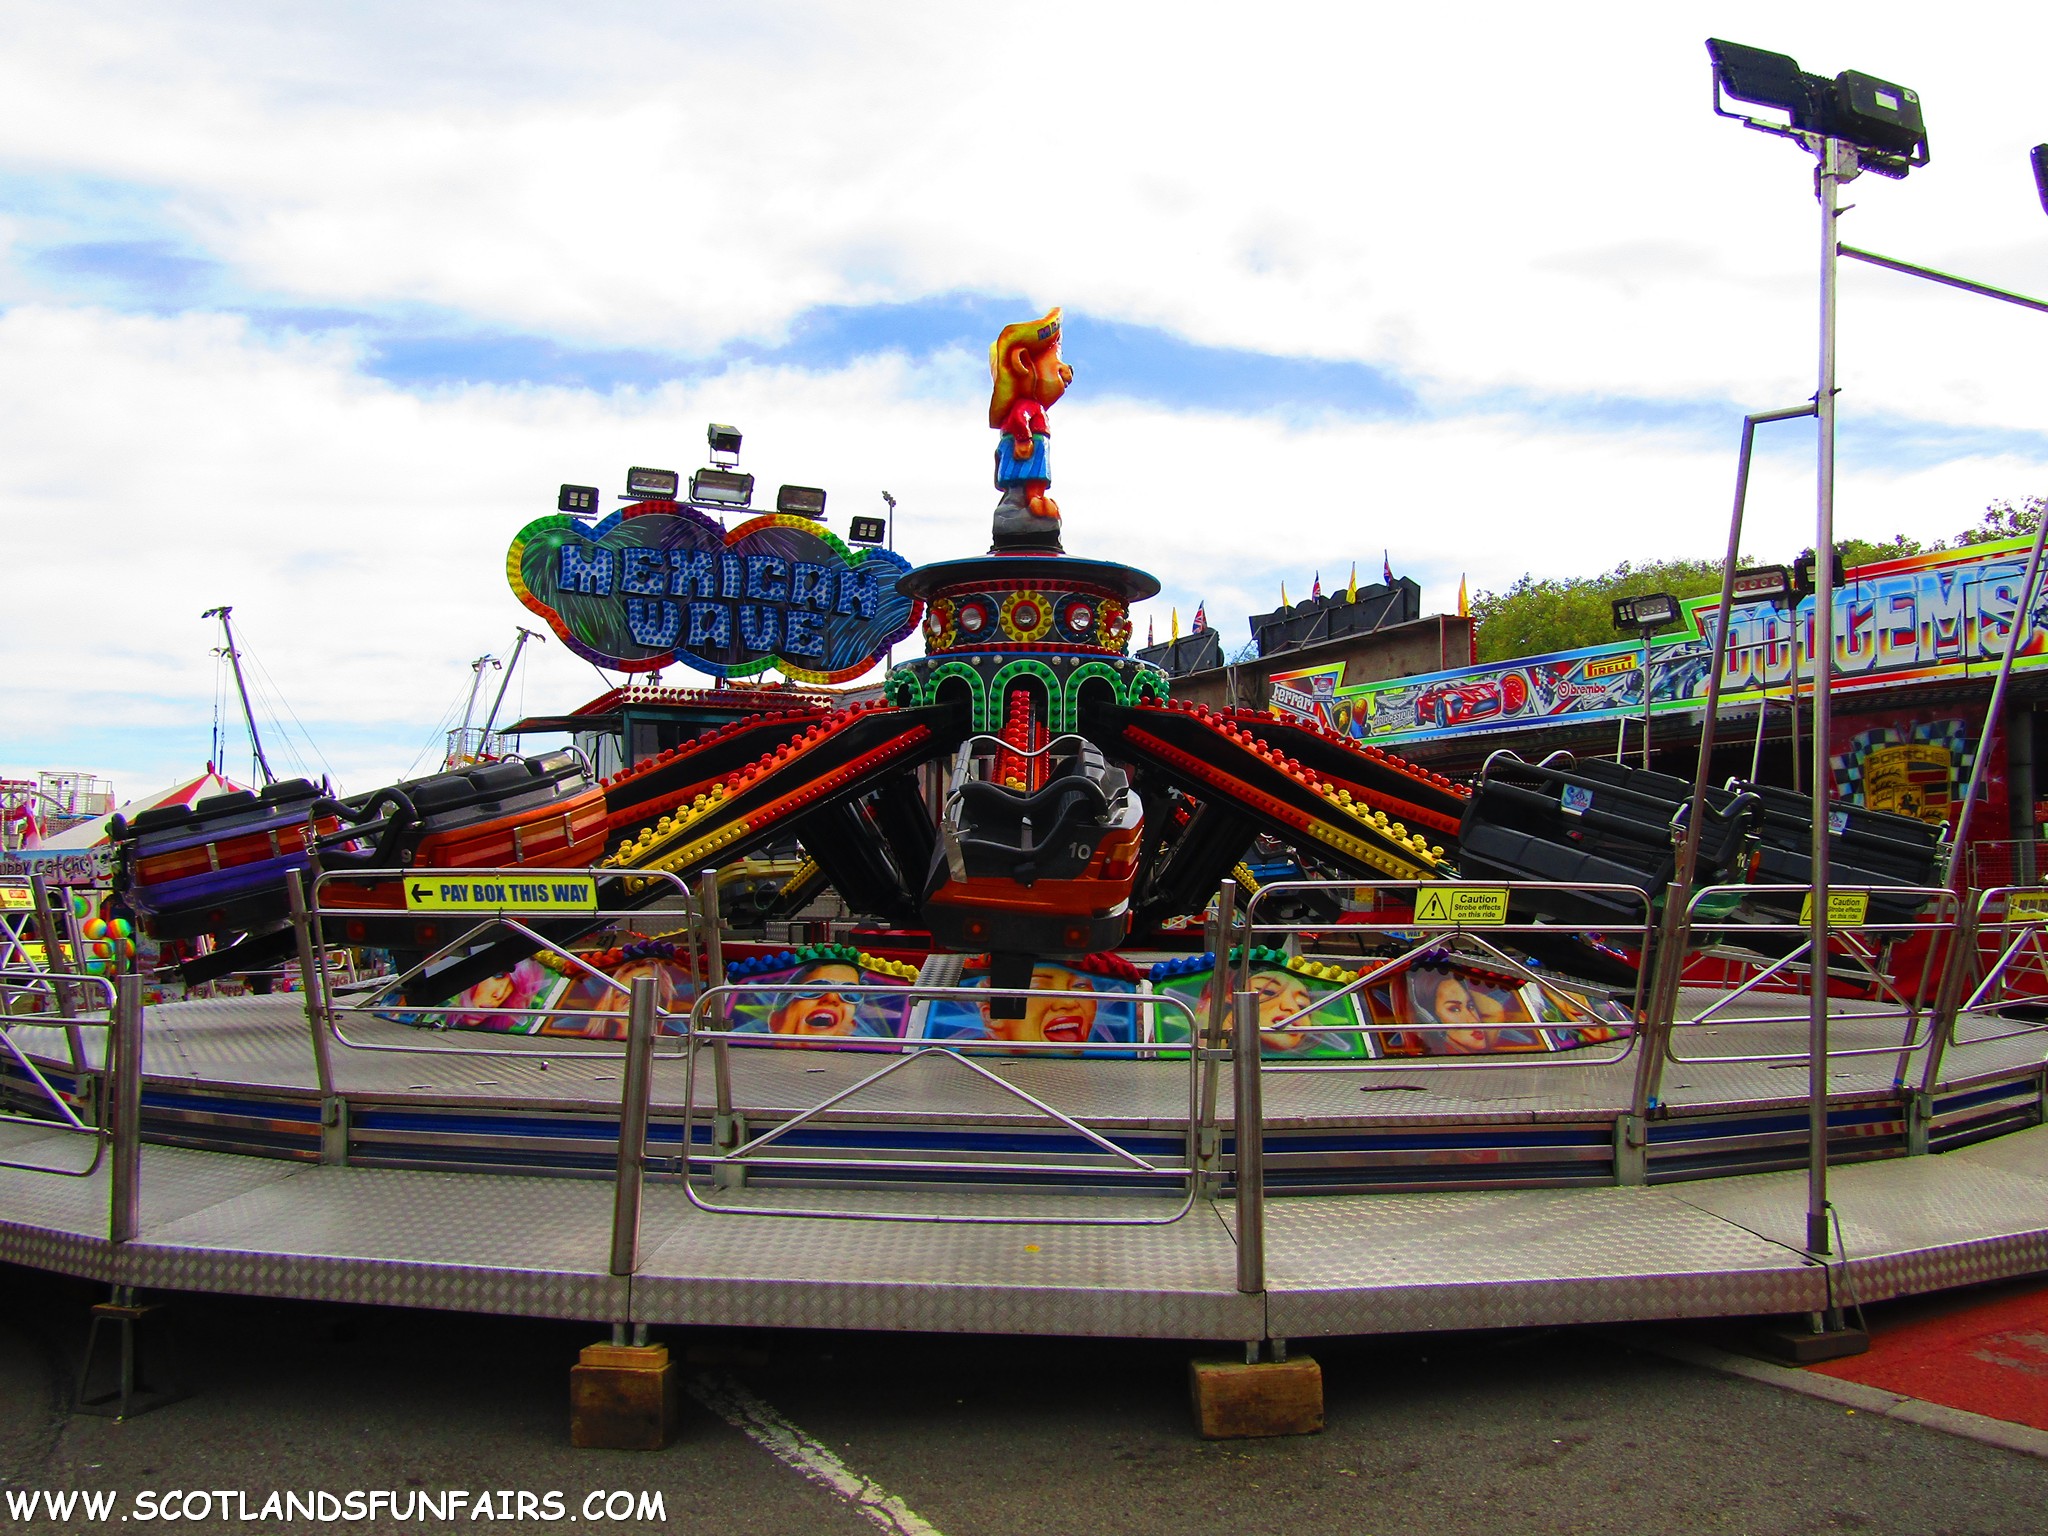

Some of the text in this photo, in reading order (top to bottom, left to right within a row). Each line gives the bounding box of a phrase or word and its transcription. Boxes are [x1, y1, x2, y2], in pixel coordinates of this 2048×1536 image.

[559, 543, 879, 619] MEXICAN
[627, 598, 825, 658] WAVE
[1587, 655, 1632, 677] PIRELLI
[1570, 683, 1606, 695] brembo
[1271, 683, 1315, 713] Ferrari
[1870, 750, 1946, 765] PORSCHE
[401, 849, 412, 863] 9
[1069, 842, 1091, 860] 10
[440, 884, 589, 902] PAY BOX THIS WAY
[1460, 894, 1498, 904] Caution
[1454, 903, 1501, 911] Strobe effects
[1832, 897, 1860, 906] Caution
